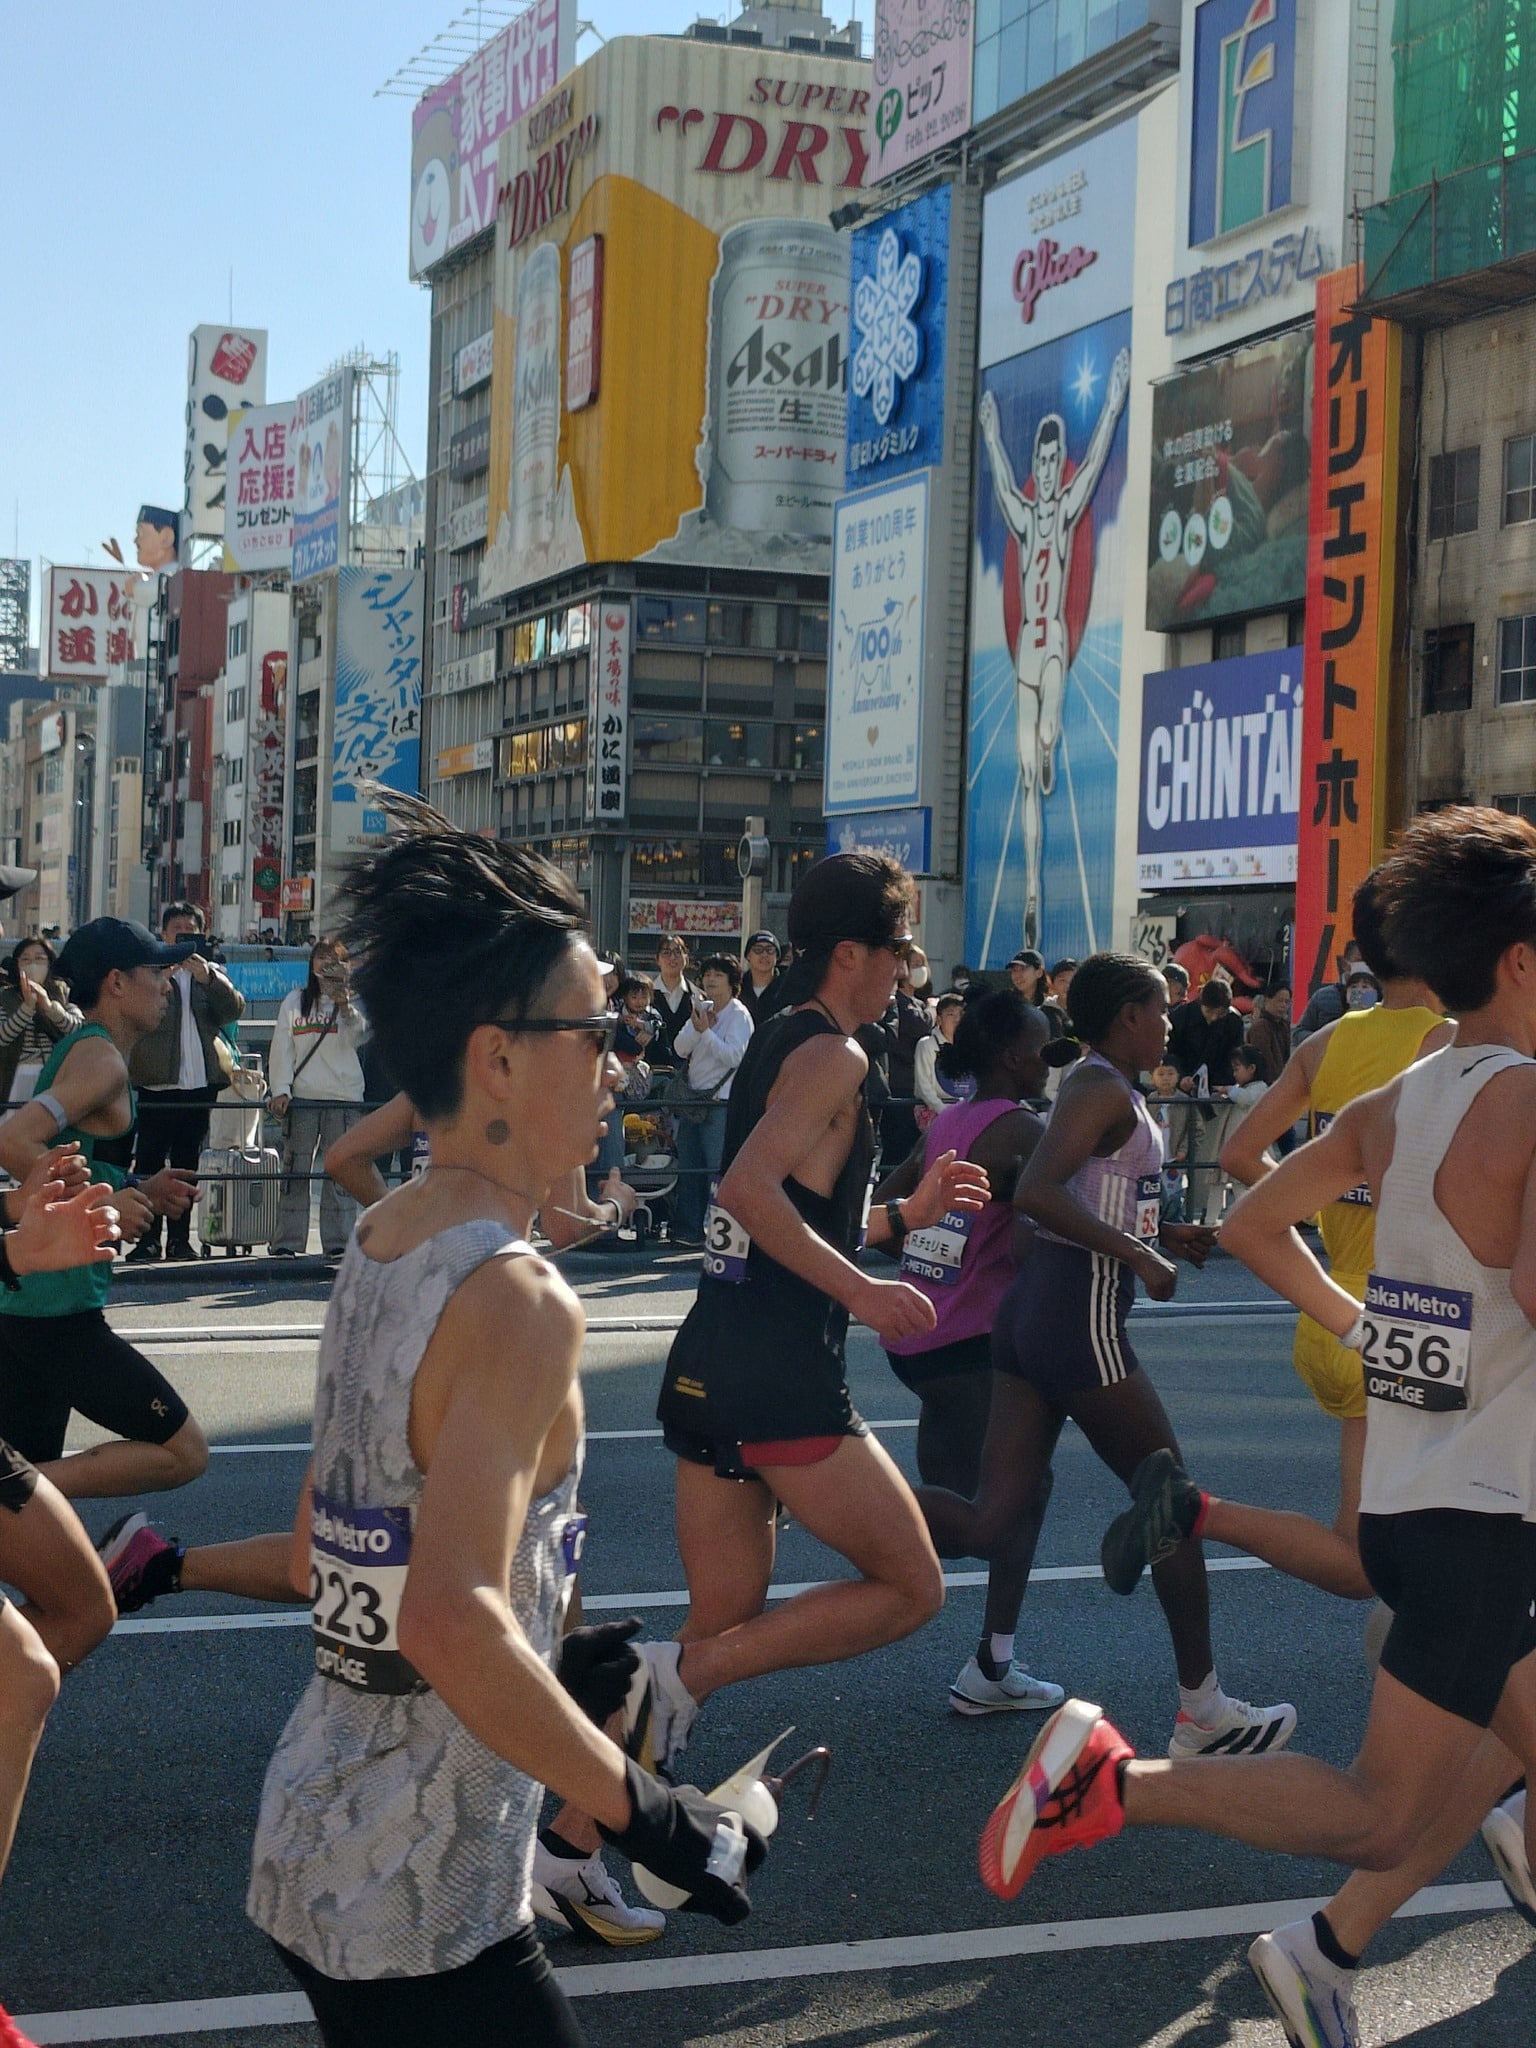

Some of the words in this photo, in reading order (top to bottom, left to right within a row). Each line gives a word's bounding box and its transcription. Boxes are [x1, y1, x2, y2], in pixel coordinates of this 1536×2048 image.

[750, 76, 869, 116] SUPER
[907, 60, 946, 120] ピップ
[527, 89, 572, 151] SUPER
[775, 279, 827, 296] SUPER
[1013, 238, 1098, 324] Glico
[1165, 225, 1324, 336] 日商エステム
[779, 398, 813, 424] 生
[239, 422, 287, 465] 入店
[753, 445, 837, 464] スーパードライ
[844, 506, 918, 554] 創業100周年
[852, 551, 907, 590] ありがとう
[1034, 540, 1053, 649] グリコ
[605, 637, 622, 709] 本場の味
[1310, 315, 1372, 995] オリエントホーム
[250, 713, 284, 851] 大阪王将
[1402, 1291, 1461, 1320] Metro
[1363, 1320, 1451, 1379] 256
[1368, 1375, 1425, 1405] OPTAGE
